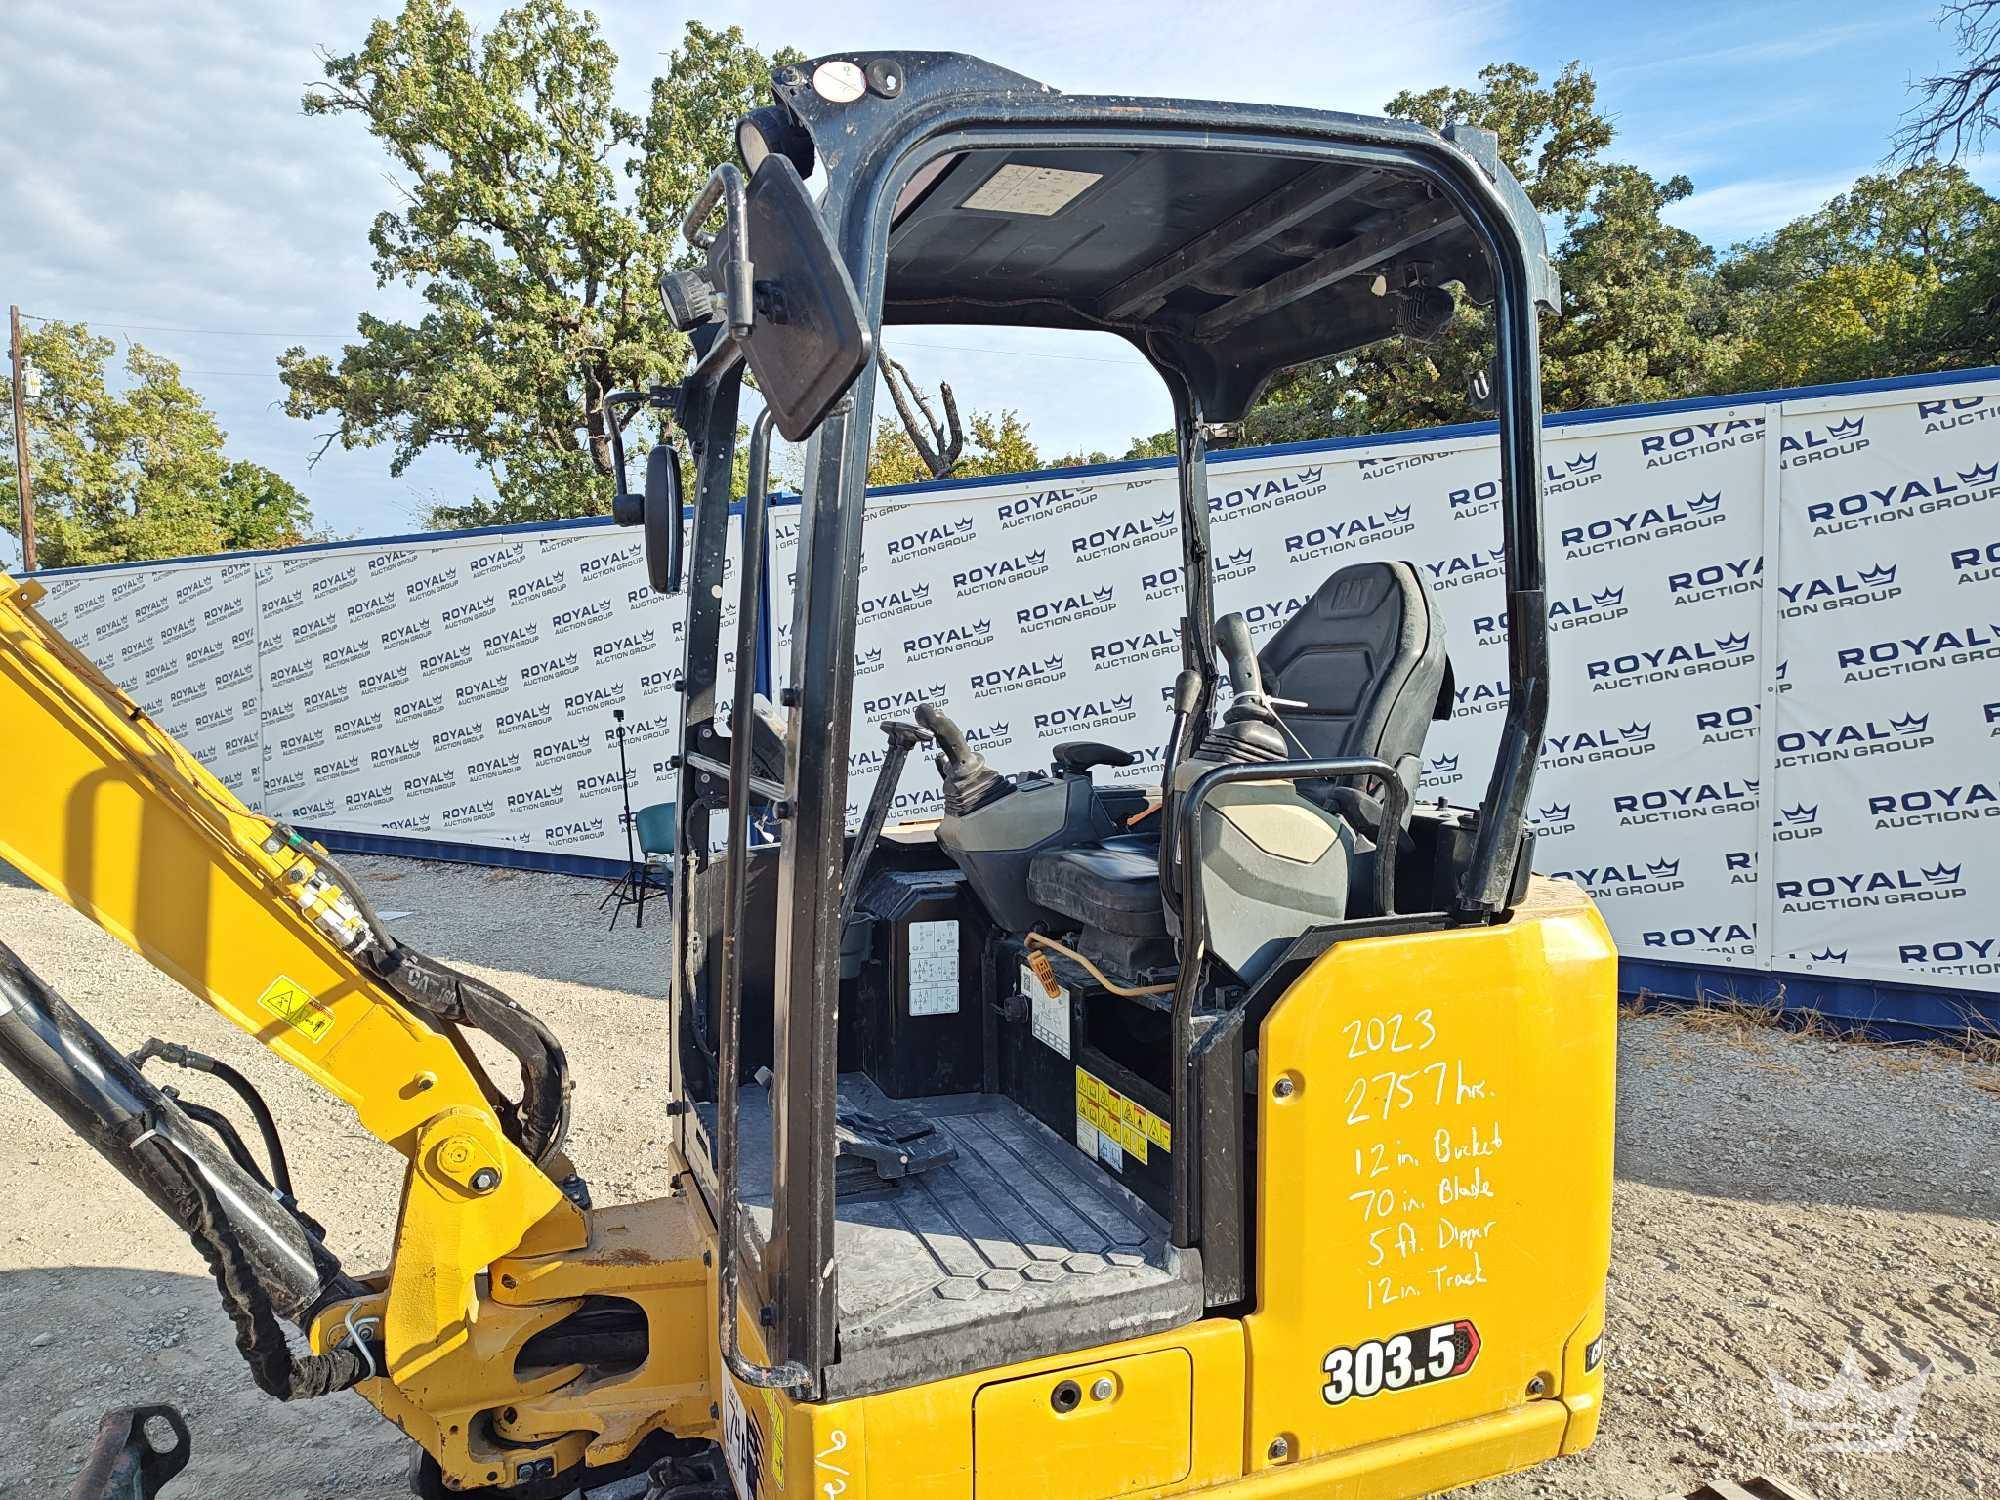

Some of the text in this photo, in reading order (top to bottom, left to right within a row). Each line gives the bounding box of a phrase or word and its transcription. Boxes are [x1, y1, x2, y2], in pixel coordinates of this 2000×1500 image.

[1646, 437, 1736, 470] AUCTION
[1792, 438, 1870, 467] GROUP
[1362, 454, 1434, 481] AUCTION
[1002, 494, 1097, 529] AUCTION GROUP
[1210, 484, 1326, 524] AUCTION GROUP
[1807, 477, 1957, 523] ROYAL
[1561, 505, 1687, 546] ROYAL
[1814, 506, 1914, 536] AUCTION
[887, 525, 955, 555] ROYAL
[1072, 519, 1153, 553] ROYAL
[1076, 527, 1177, 563] AUCTION GROUP
[1285, 515, 1384, 552] ROYAL
[1290, 523, 1414, 563] AUCTION GROUP
[1567, 514, 1725, 558] AUCTION GROUP
[470, 549, 513, 571] ROYAL
[890, 532, 975, 564] AUCTION GROUP
[473, 564, 501, 578] AUCTION
[580, 550, 628, 574] ROYAL
[583, 566, 615, 581] AUCTION
[953, 557, 1026, 587] ROYAL
[312, 572, 347, 593] ROYAL
[508, 576, 552, 599] ROYAL
[957, 565, 1048, 597] AUCTION GROUP
[204, 601, 234, 620] ROYAL
[511, 592, 540, 607] AUCTION
[896, 599, 933, 615] GROUP
[1017, 594, 1093, 623] ROYAL
[1823, 587, 1902, 611] GROUP
[442, 601, 484, 622] ROYAL
[445, 615, 472, 629] AUCTION
[1020, 602, 1116, 633] AUCTION GROUP
[1562, 607, 1628, 631] GROUP
[483, 628, 526, 649] ROYAL
[486, 643, 514, 656] AUCTION
[593, 635, 641, 657] ROYAL
[903, 627, 972, 653] ROYAL
[907, 635, 993, 662] AUCTION GROUP
[1091, 629, 1170, 660] ROYAL
[1838, 628, 1991, 668] ROYAL
[420, 650, 460, 670] ROYAL
[521, 658, 565, 679] ROYAL
[595, 651, 628, 664] AUCTION
[1095, 648, 1149, 671] AUCTION
[1587, 643, 1715, 679] ROYAL
[1844, 656, 1946, 683] AUCTION
[270, 663, 303, 681] ROYAL
[422, 664, 449, 677] AUCTION
[523, 673, 553, 686] AUCTION
[971, 662, 1044, 689] ROYAL
[1593, 654, 1754, 691] AUCTION GROUP
[456, 679, 496, 698] ROYAL
[974, 671, 1066, 698] AUCTION GROUP
[458, 693, 485, 705] AUCTION
[564, 687, 611, 708] ROYAL
[567, 703, 598, 716] AUCTION
[864, 689, 928, 713] ROYAL
[496, 708, 538, 727] ROYAL
[867, 707, 910, 722] AUCTION
[1034, 702, 1112, 728] ROYAL
[1038, 712, 1135, 738] AUCTION GROUP
[498, 723, 527, 735] AUCTION
[1777, 722, 1891, 753] OYAL
[533, 740, 578, 759] ROYAL
[1588, 743, 1655, 763] GROUP
[1853, 736, 1935, 757] GROUP
[536, 755, 565, 766] AUCTION
[404, 773, 444, 790] ROYAL
[406, 786, 433, 797] AUCTION
[507, 788, 550, 806] ROYAL
[509, 803, 538, 813] AUCTION
[1614, 782, 1744, 813] ROYAL
[1620, 807, 1706, 825] AUCTION
[1874, 809, 1980, 830] AUCTION
[545, 822, 590, 839] ROYAL
[548, 836, 578, 846] AUCTION
[1616, 881, 1684, 897] GROUP
[1776, 871, 1921, 899] ROYAL
[1783, 888, 1965, 912] AUCTION GROUP
[1343, 1008, 1437, 1059] 2023
[1345, 1062, 1446, 1126] 2757
[1355, 1120, 1503, 1178] 12 in. Bucket
[1349, 1167, 1494, 1222] 70 in. Blade
[1368, 1226, 1392, 1266] 5
[1395, 1222, 1424, 1258] ft.
[1428, 1251, 1487, 1293] Track
[1324, 1323, 1455, 1403] 303.5
